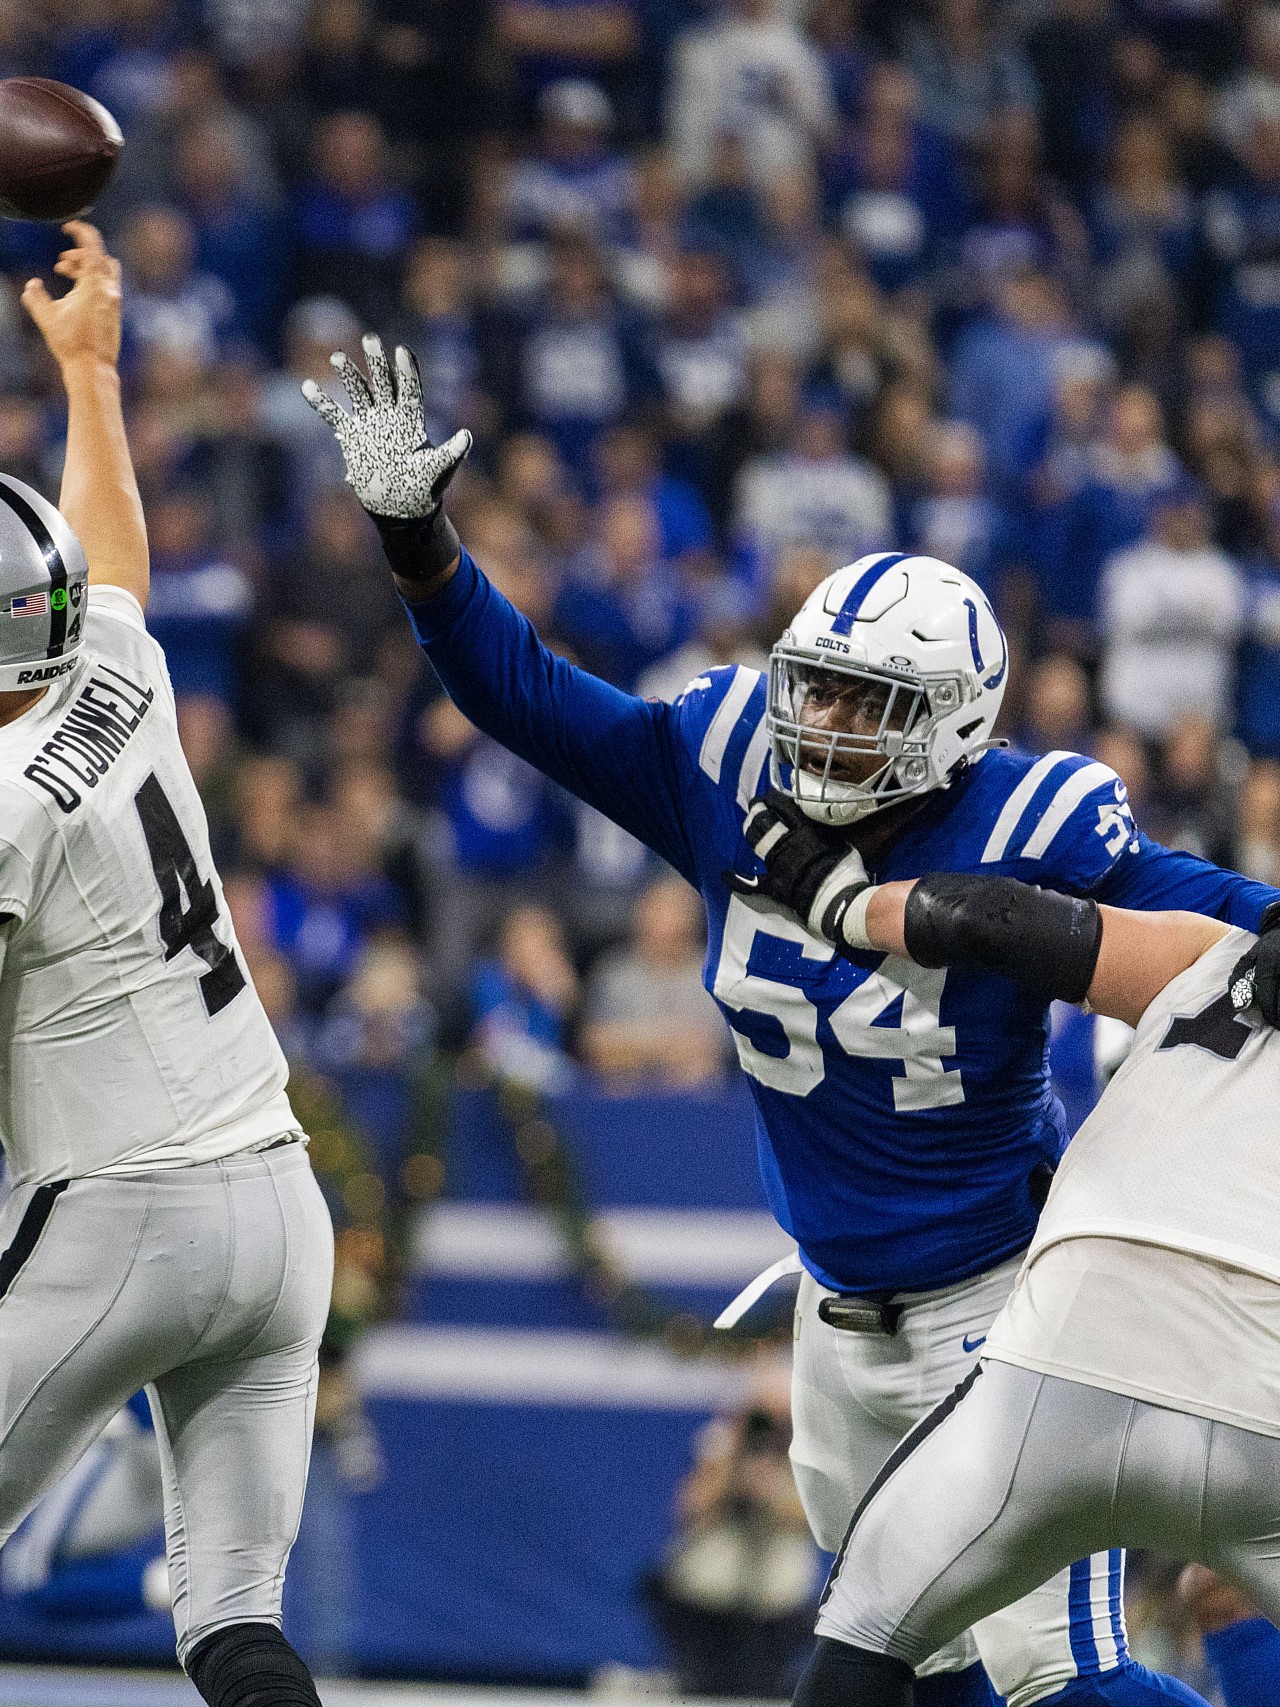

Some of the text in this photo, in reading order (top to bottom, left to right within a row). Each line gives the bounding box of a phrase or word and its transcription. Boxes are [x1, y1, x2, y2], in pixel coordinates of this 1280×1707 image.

[815, 637, 851, 654] COLTS
[23, 664, 155, 814] O'CONNELL
[134, 770, 248, 1020] 4
[713, 892, 966, 1112] 54
